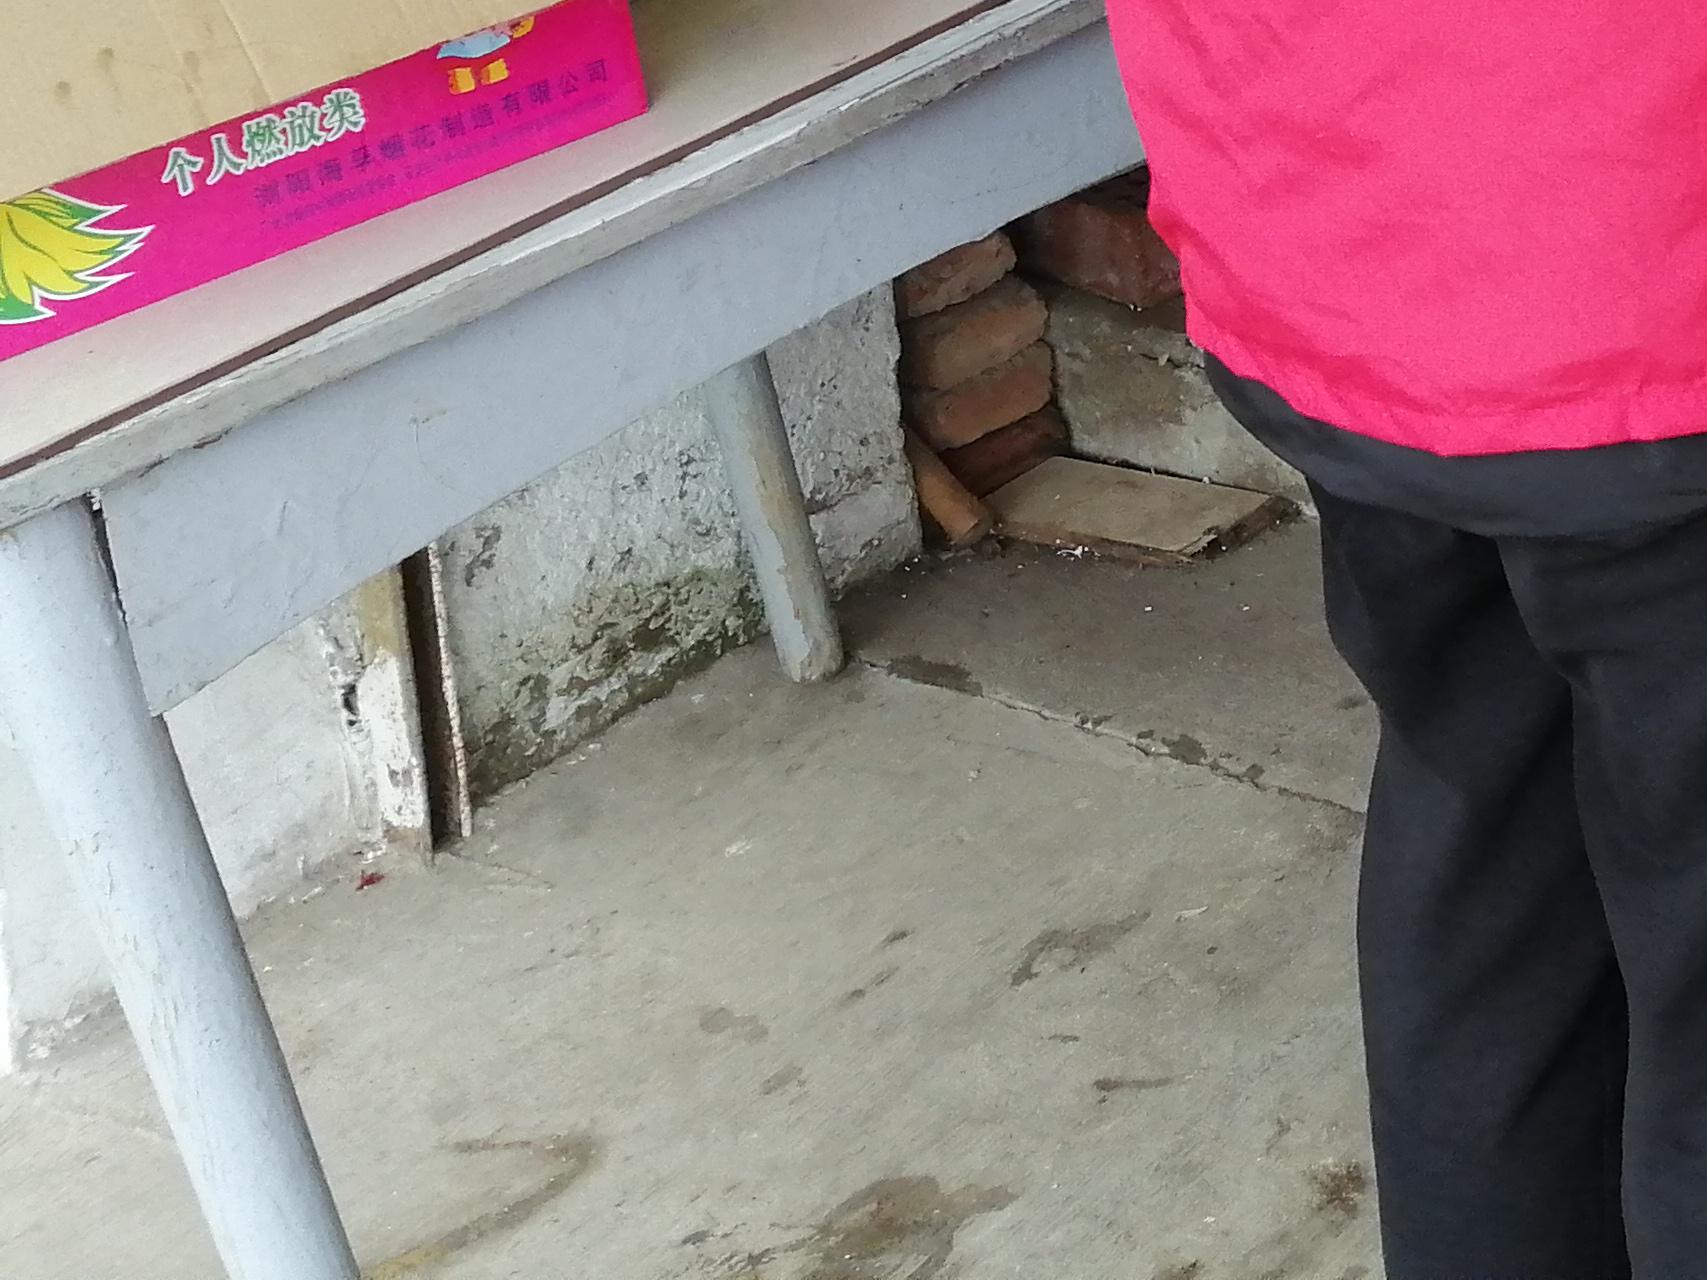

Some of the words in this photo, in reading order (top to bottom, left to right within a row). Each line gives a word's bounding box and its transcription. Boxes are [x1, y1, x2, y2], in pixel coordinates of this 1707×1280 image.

[161, 88, 366, 196] 个人燃放类
